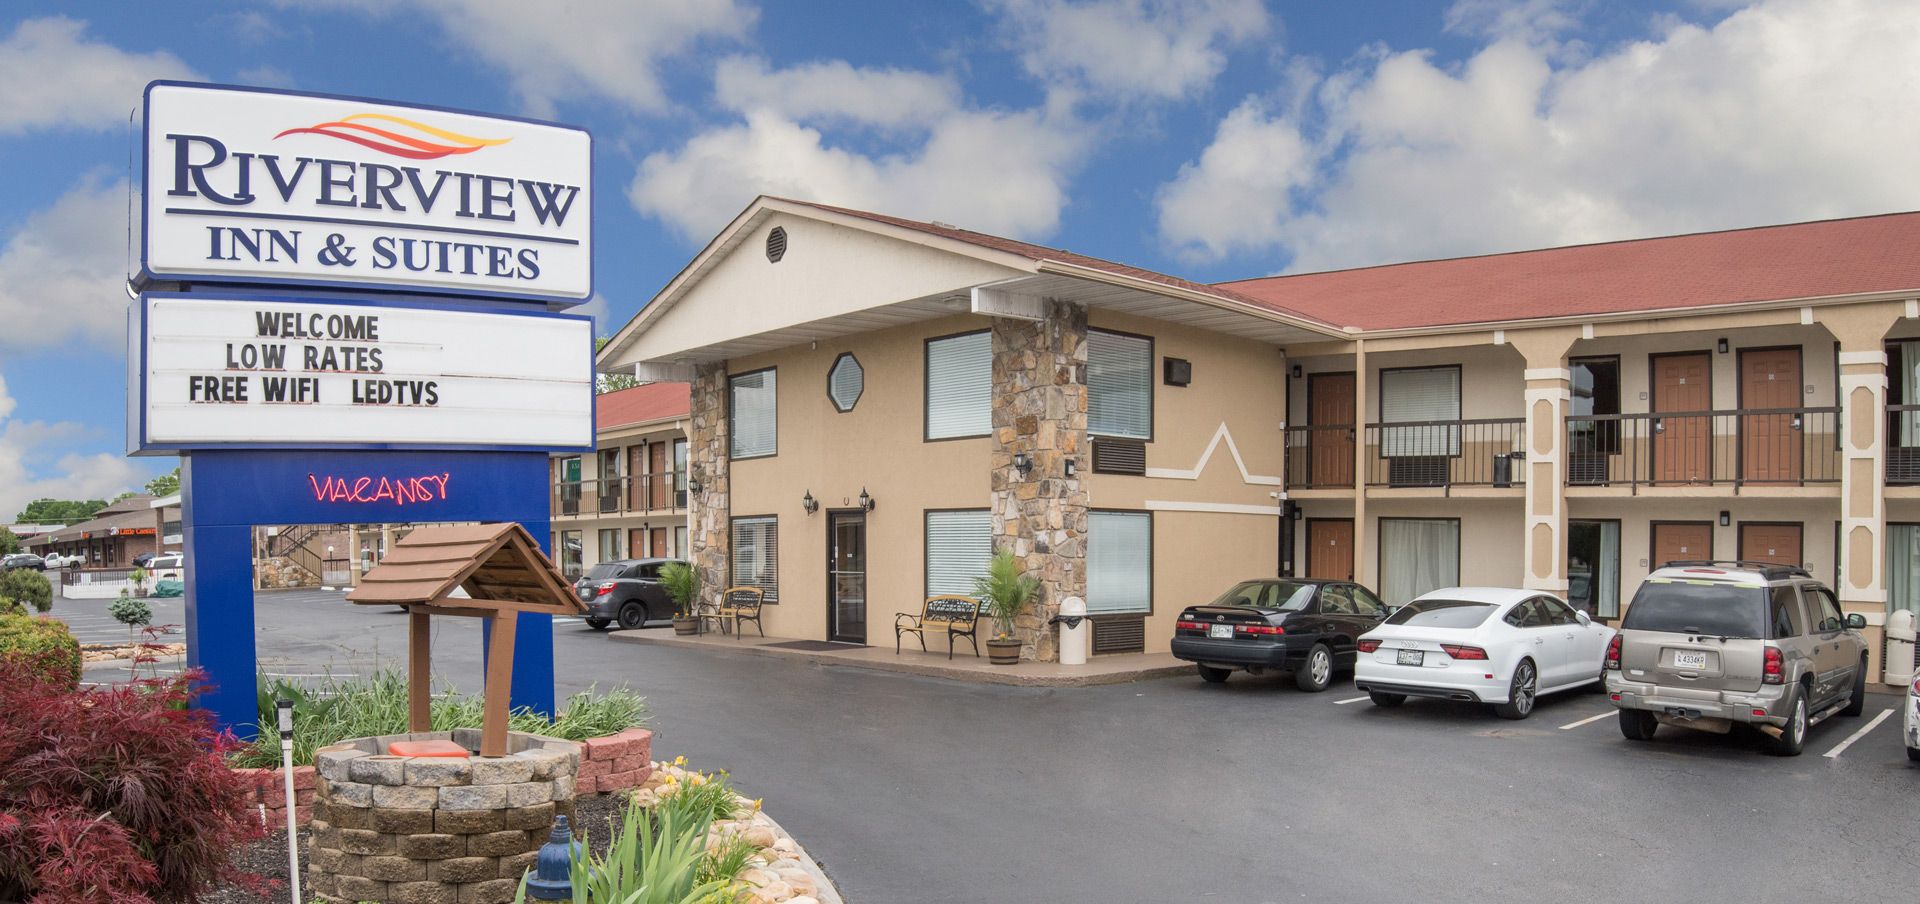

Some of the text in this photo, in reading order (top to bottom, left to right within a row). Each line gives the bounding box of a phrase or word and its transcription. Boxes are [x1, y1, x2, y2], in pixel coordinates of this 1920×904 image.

[166, 133, 581, 227] RIVERVIEW
[206, 226, 541, 280] INN & SUITES
[255, 311, 379, 340] WELCOME
[226, 343, 383, 372] LOW RATES
[189, 375, 439, 405] FREE WIFI LEDTVS
[309, 473, 449, 505] VACANCY
